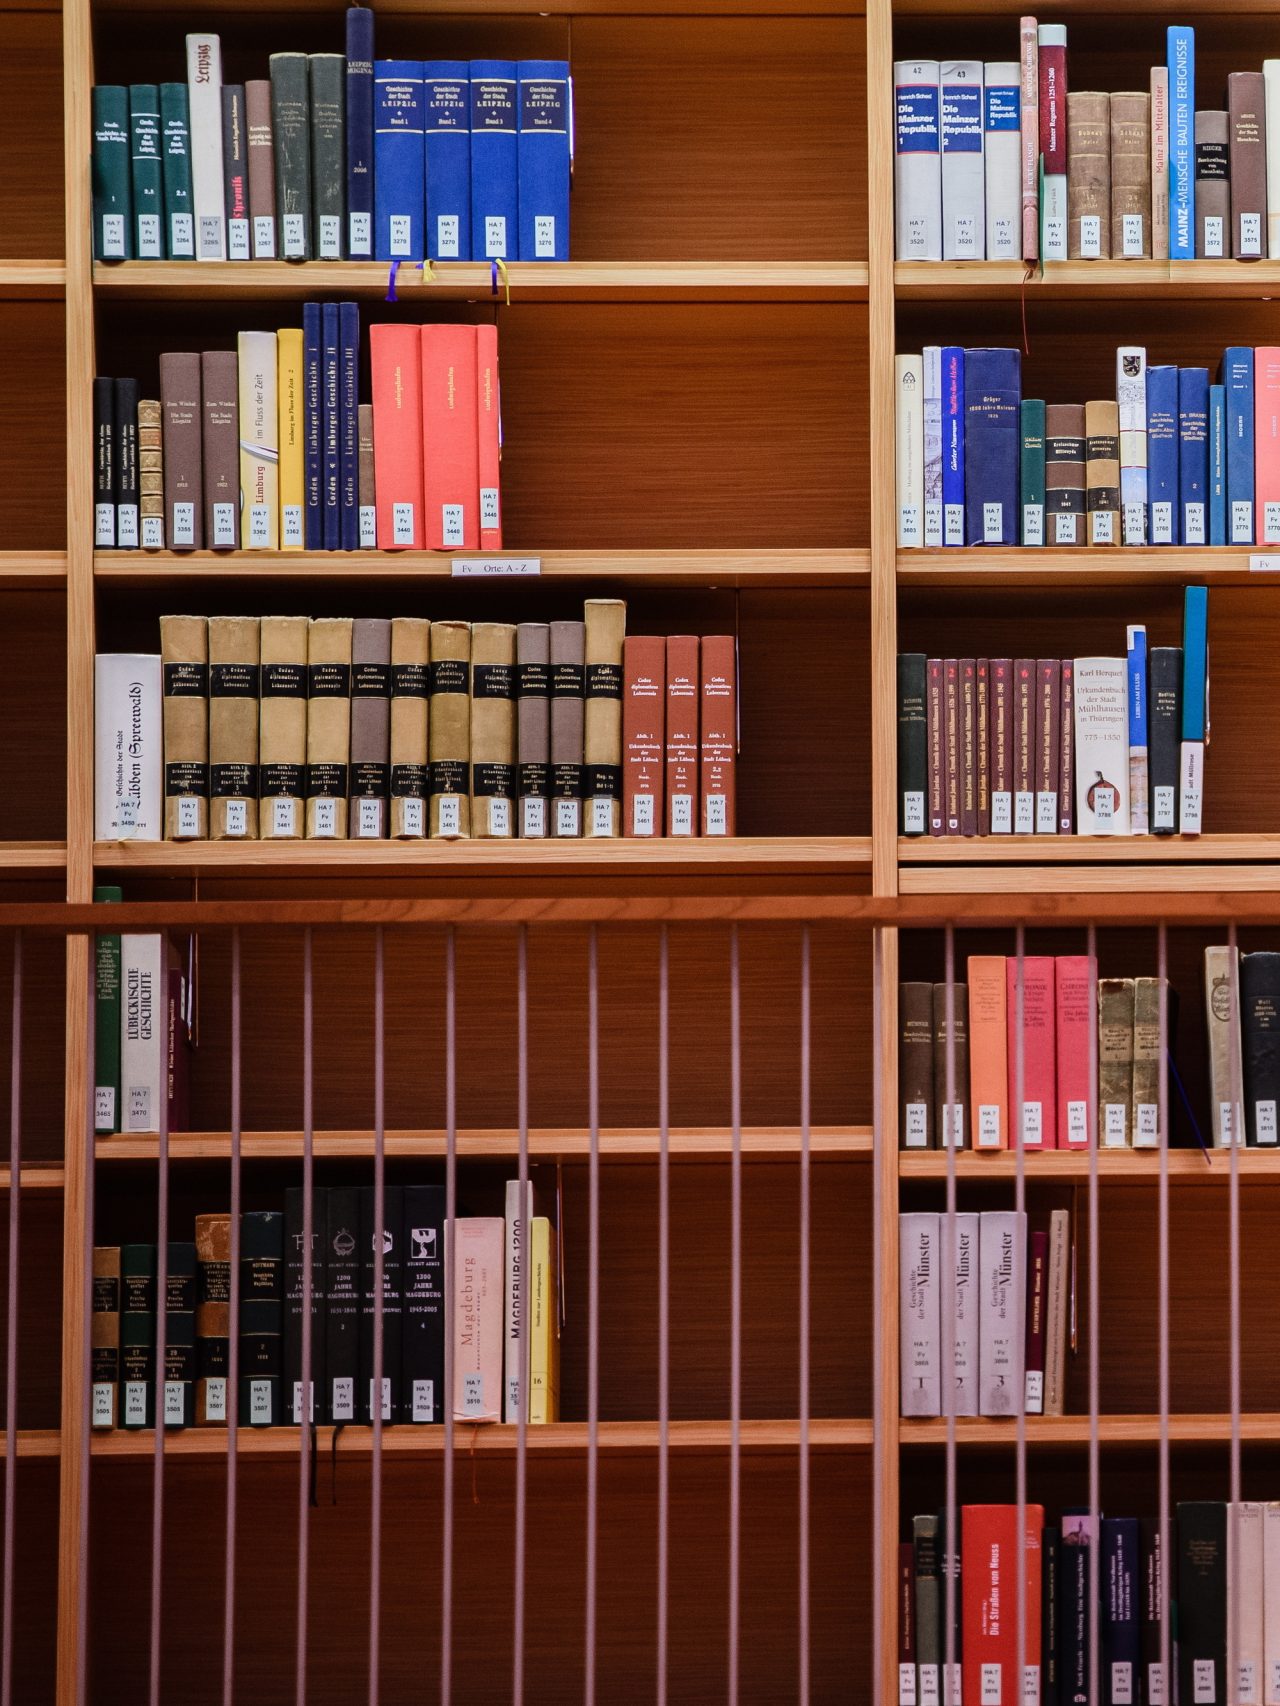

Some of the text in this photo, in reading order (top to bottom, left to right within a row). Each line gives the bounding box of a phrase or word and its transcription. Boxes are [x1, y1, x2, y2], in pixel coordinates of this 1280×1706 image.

[195, 44, 211, 83] Leipzig
[1177, 39, 1187, 99] EREIGNISSE
[899, 116, 934, 124] Mainzer
[943, 105, 958, 113] Die
[943, 116, 979, 124] Mainzer
[1155, 85, 1163, 173] Mainz im Mittelalter
[1177, 103, 1187, 147] BAUTEN
[899, 126, 937, 135] Republik
[943, 126, 982, 134] Republik
[309, 361, 318, 408] Geschichte
[254, 374, 263, 439] im Fluss der Zeit
[309, 411, 319, 454] Limburger
[255, 466, 265, 503] Limburg
[462, 564, 472, 573] Fv
[506, 564, 513, 572] A
[1080, 669, 1094, 677] Karl
[128, 682, 144, 758] (Spreewald)
[1078, 705, 1126, 713] Mühlhausen
[1088, 715, 1124, 723] Thüringen
[140, 972, 152, 1040] GESCHICHTE
[917, 1232, 930, 1287] Münster
[957, 1233, 969, 1287] Münster
[999, 1232, 1012, 1287] Münster
[460, 1258, 476, 1345] Magdeburg
[918, 1378, 924, 1388] 1
[956, 1378, 963, 1388] 2
[989, 1543, 999, 1636] Die Straßen von Neuss
